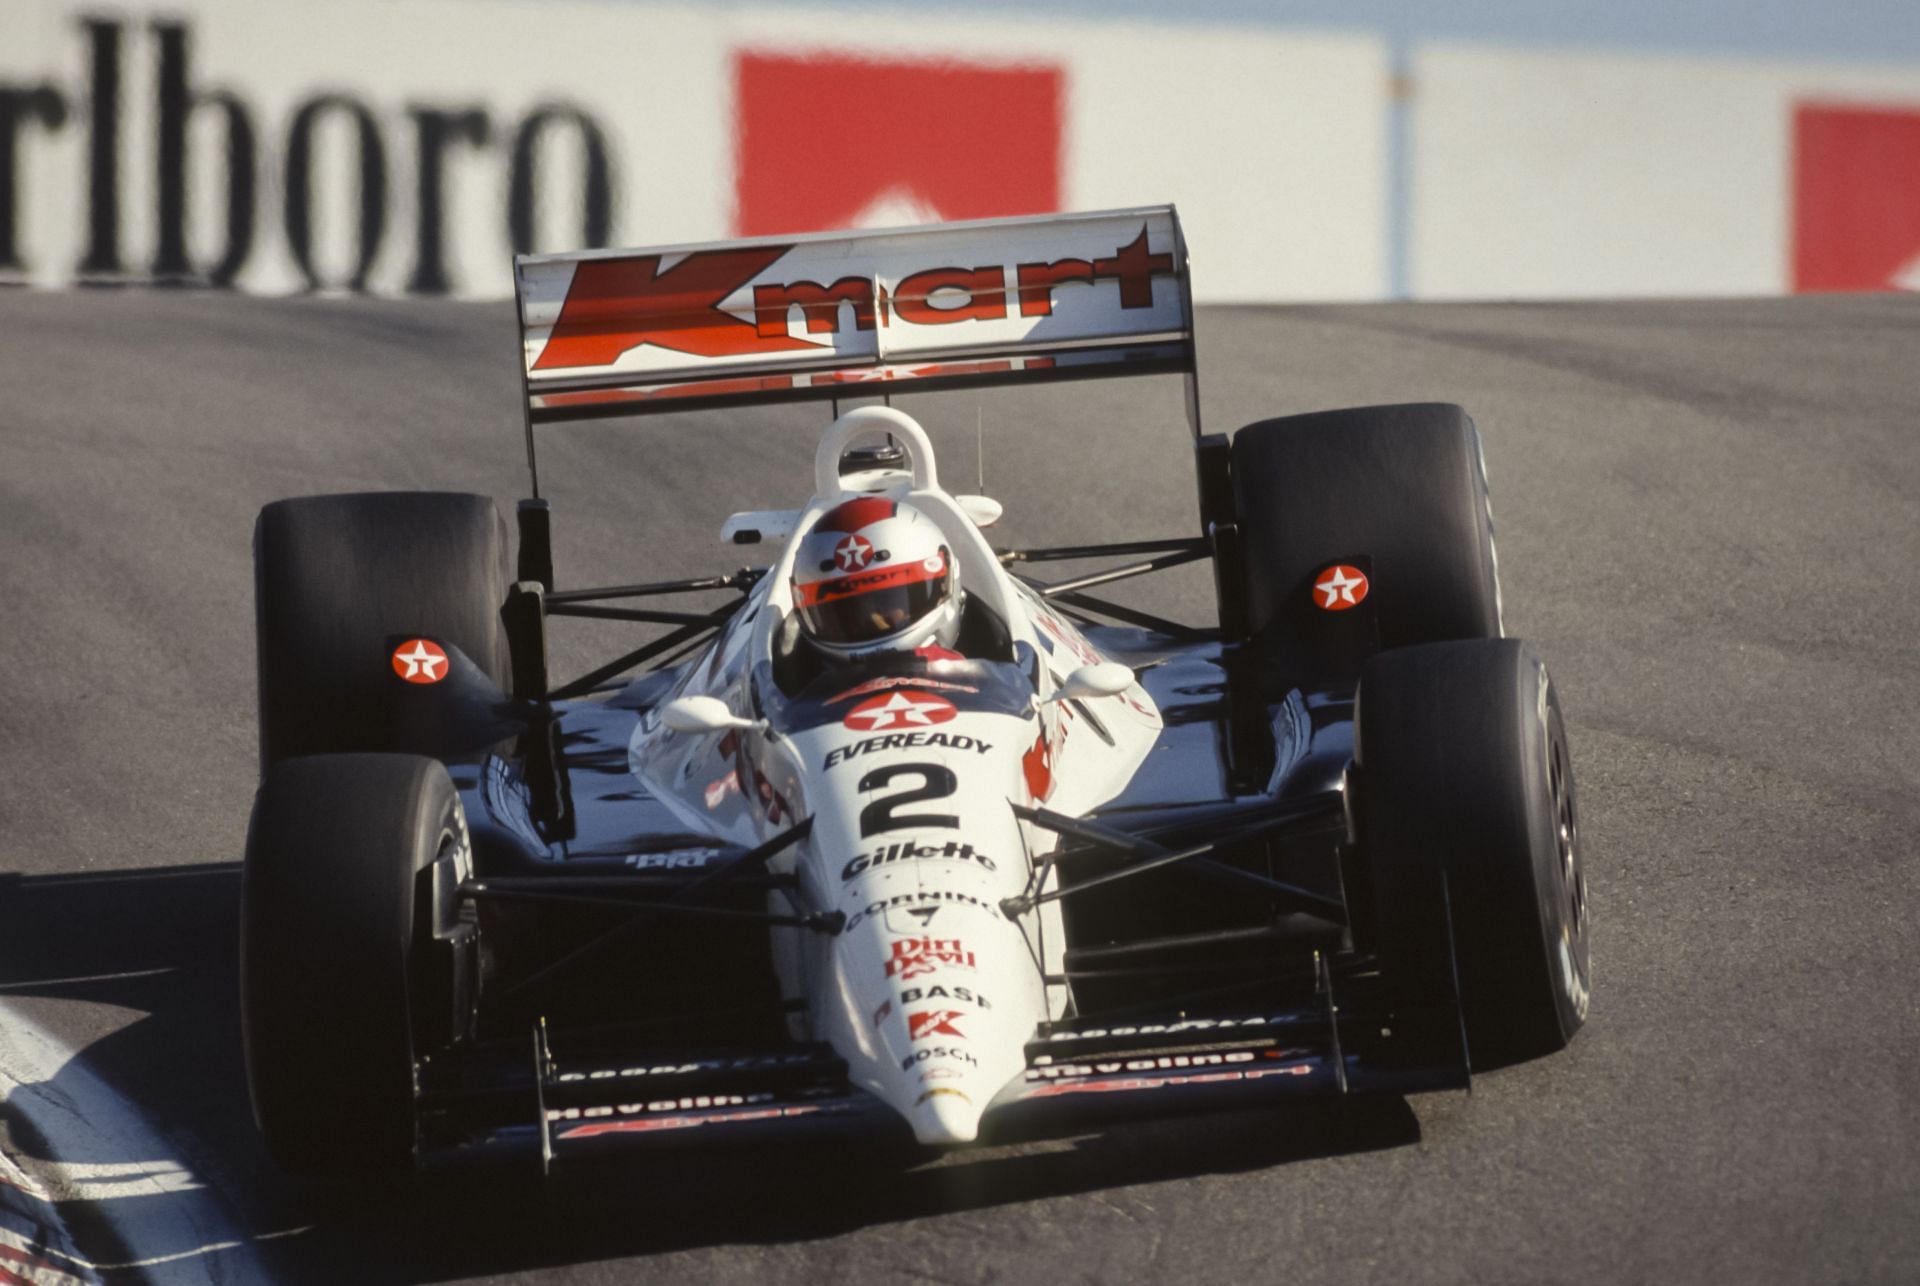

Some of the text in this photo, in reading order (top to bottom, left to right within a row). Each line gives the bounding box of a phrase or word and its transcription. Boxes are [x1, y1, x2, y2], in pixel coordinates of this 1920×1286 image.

[529, 221, 1174, 371] Kmart
[823, 732, 993, 772] EVEREADY
[858, 762, 960, 840] 2
[841, 841, 997, 882] Gillette
[902, 1046, 977, 1072] BOSCH
